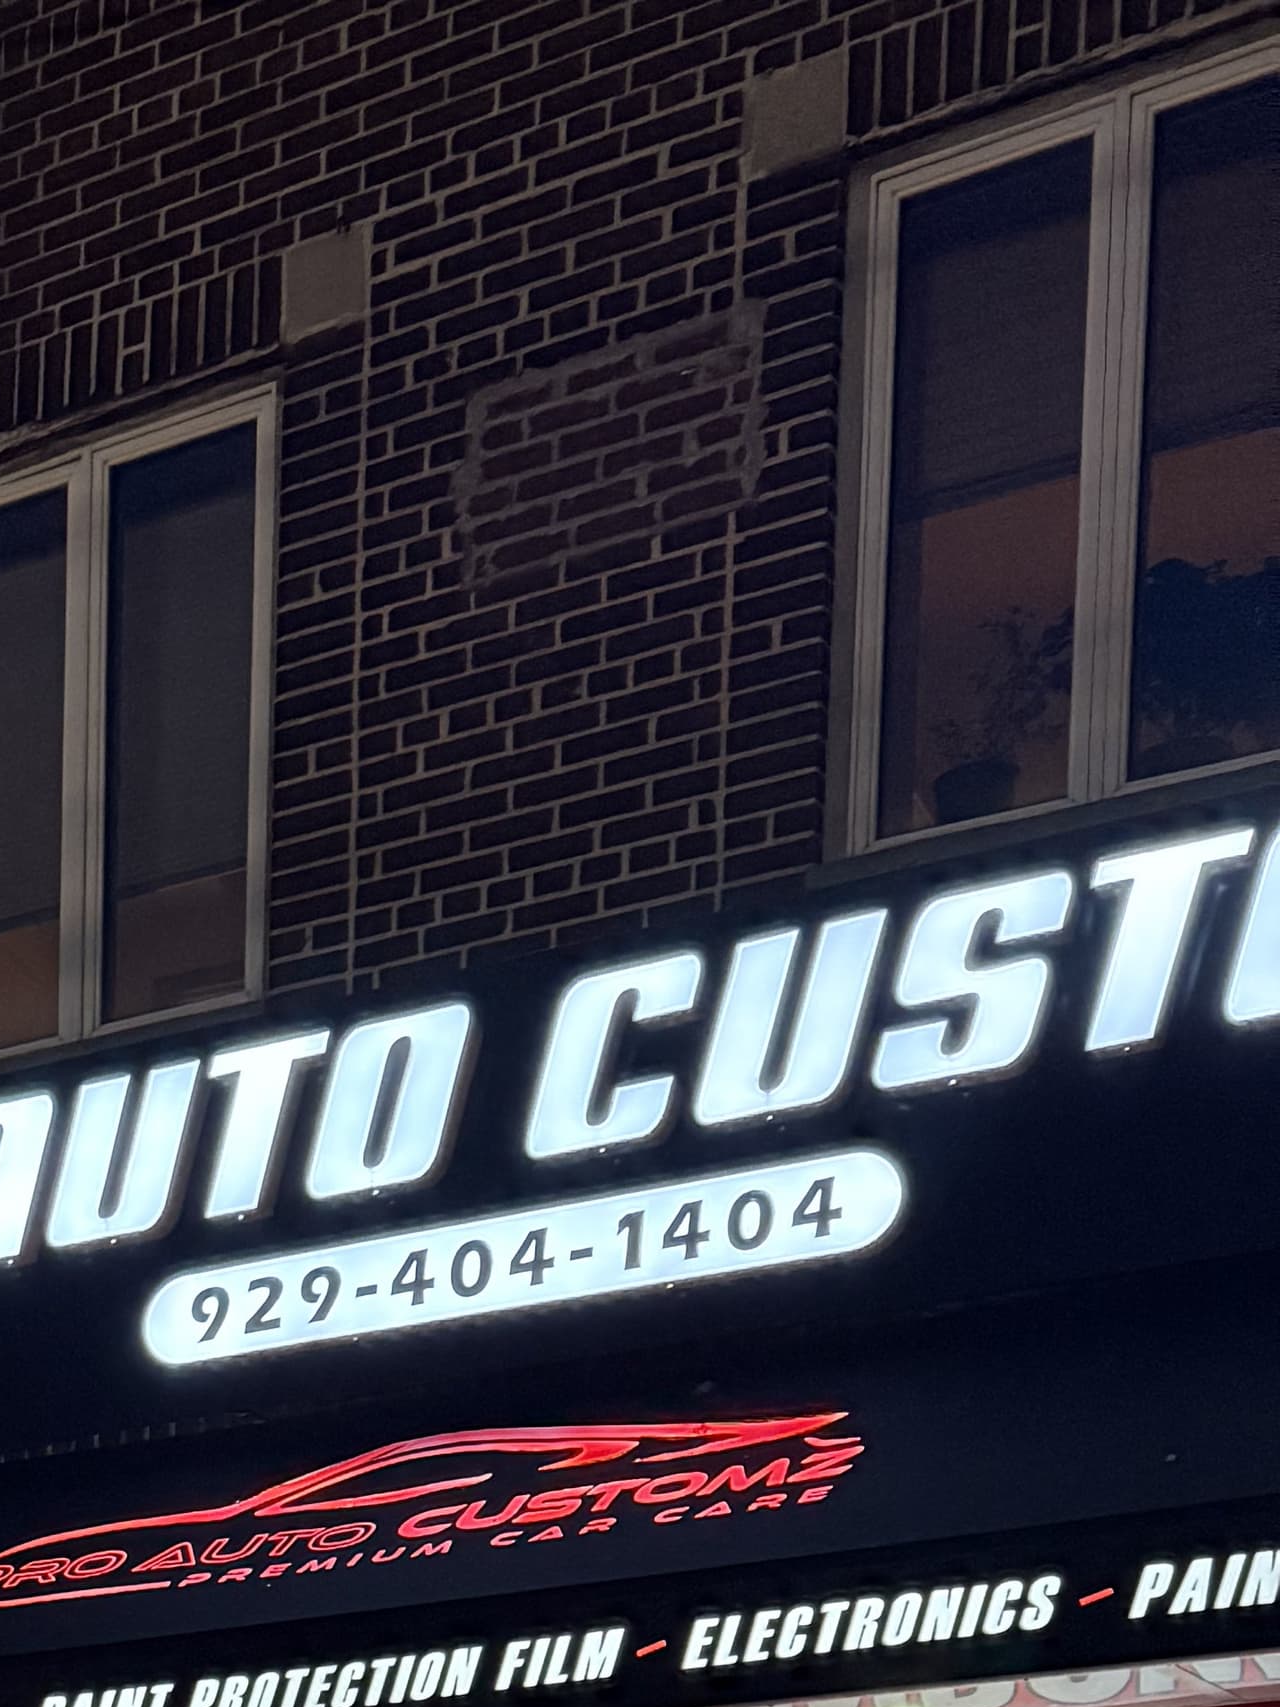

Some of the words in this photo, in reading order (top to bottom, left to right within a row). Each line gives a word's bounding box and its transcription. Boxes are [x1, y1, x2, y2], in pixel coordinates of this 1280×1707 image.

[191, 1177, 842, 1342] 929-404-1404
[133, 1522, 378, 1573] AUTO
[397, 1440, 866, 1539] CUSTOMZ
[178, 1538, 454, 1588] PREMIUM
[490, 1519, 615, 1547] CAR
[653, 1484, 833, 1524] CARE
[494, 1627, 626, 1693] FILM
[681, 1575, 1062, 1671] ELECTRONICS
